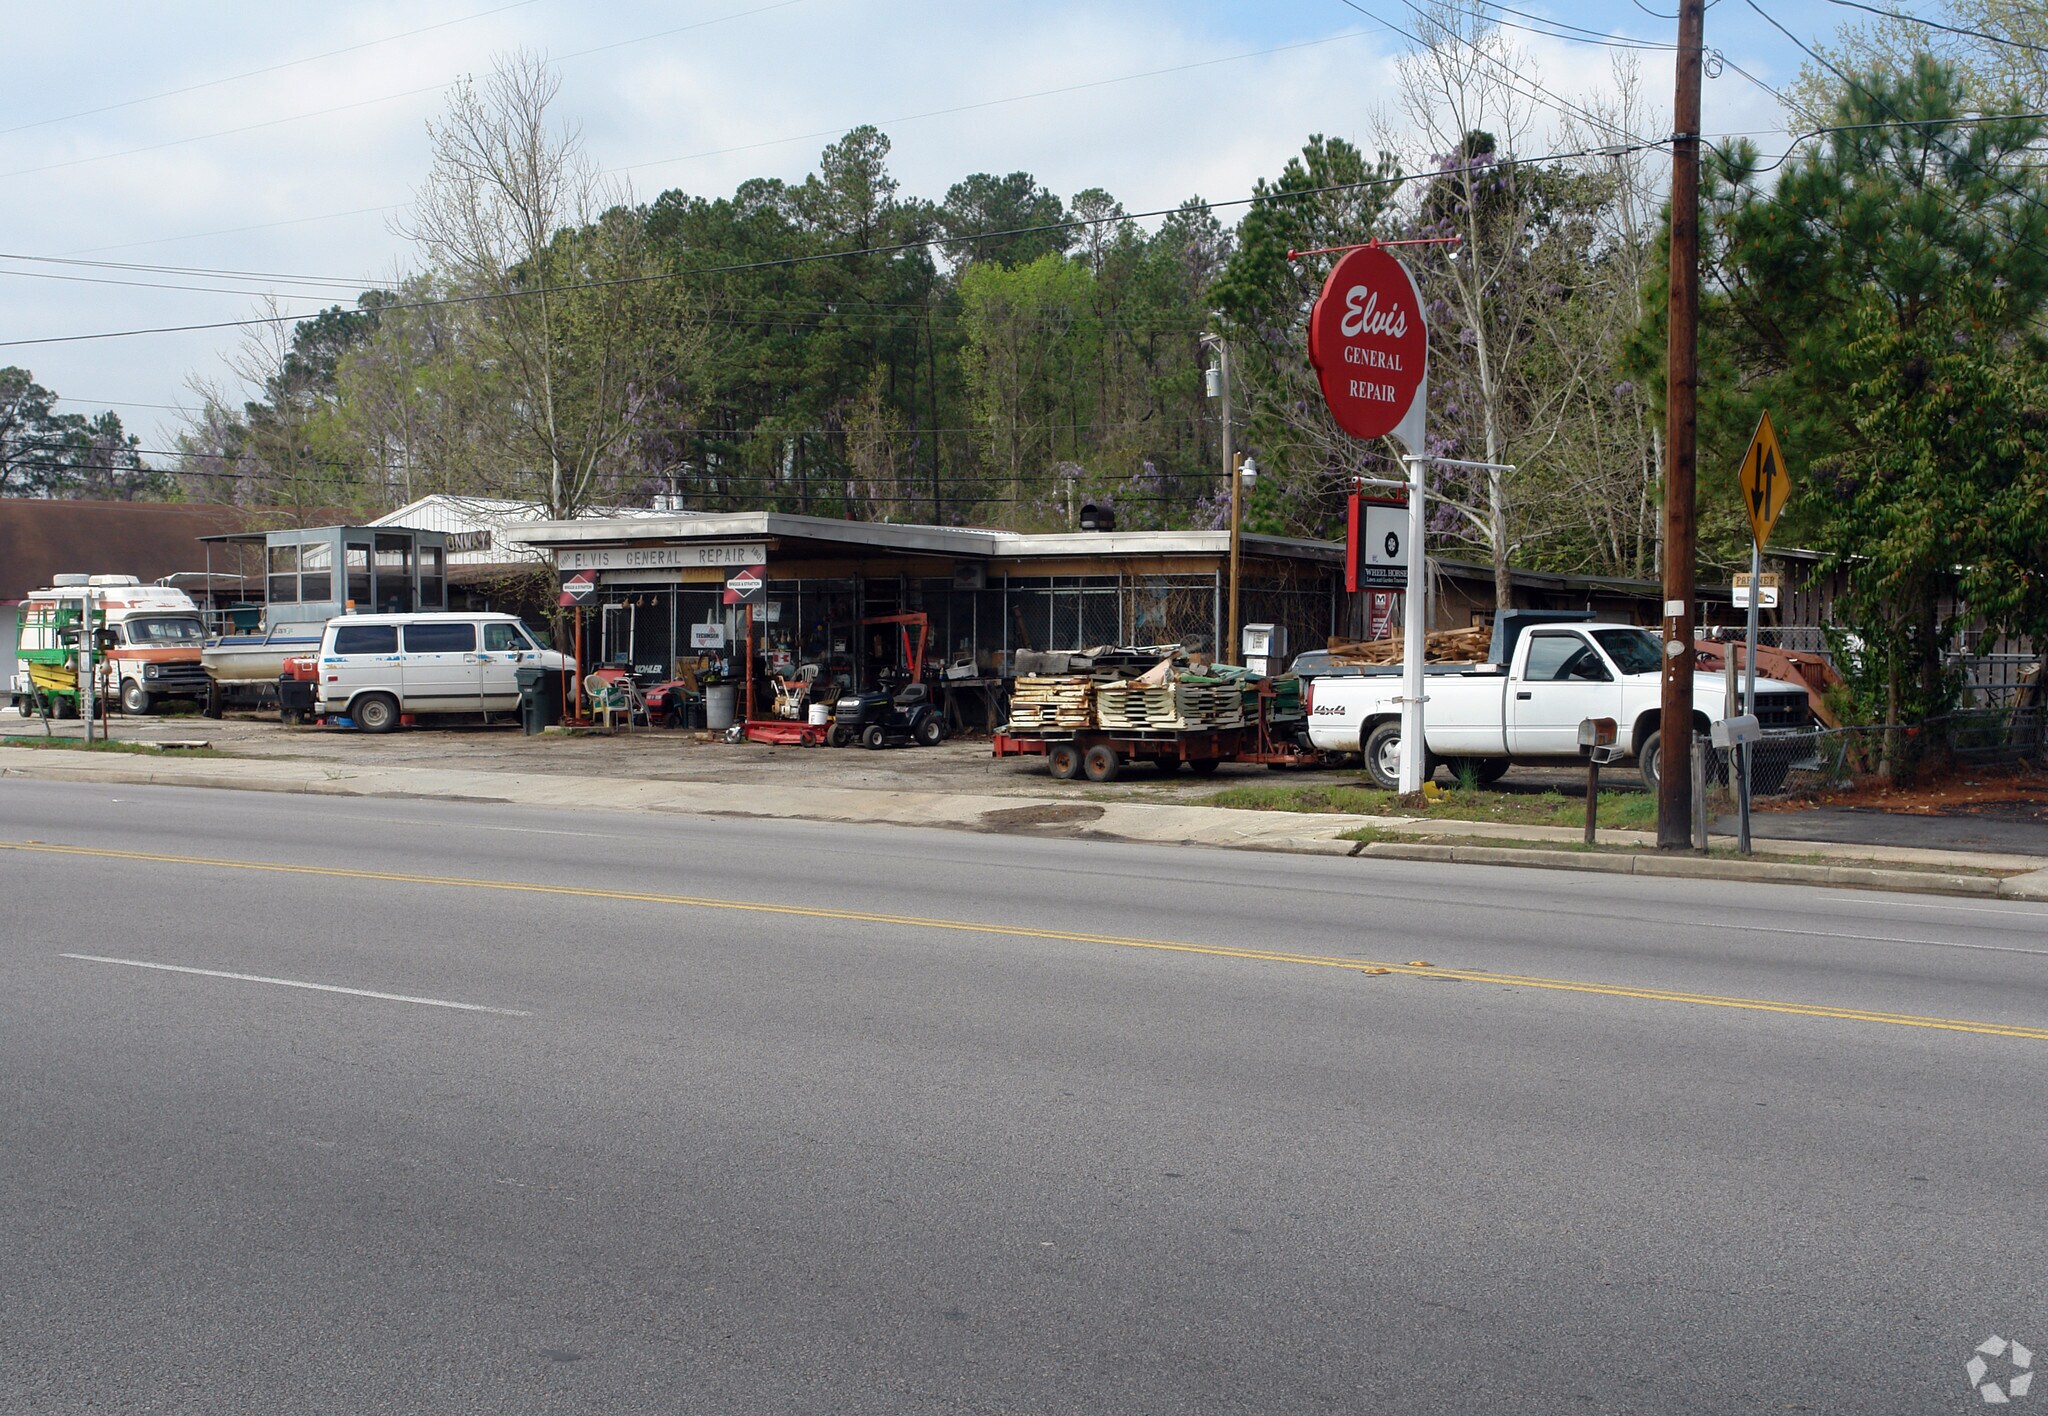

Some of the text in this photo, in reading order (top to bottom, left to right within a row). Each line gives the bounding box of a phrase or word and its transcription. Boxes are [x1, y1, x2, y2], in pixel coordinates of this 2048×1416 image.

[1341, 285, 1408, 338] Elvis
[1344, 345, 1403, 371] GENERAL
[1349, 380, 1396, 403] REPAIR
[575, 552, 609, 567] ELVIS
[626, 550, 681, 565] GENERAL
[699, 548, 745, 563] REPAIR
[751, 546, 764, 562] 1801
[1365, 568, 1409, 578] WHEEL HORSE
[1736, 576, 1775, 585] PARNER
[1376, 595, 1385, 604] M
[634, 664, 663, 674] KOHLER
[1314, 705, 1346, 716] 4x4
